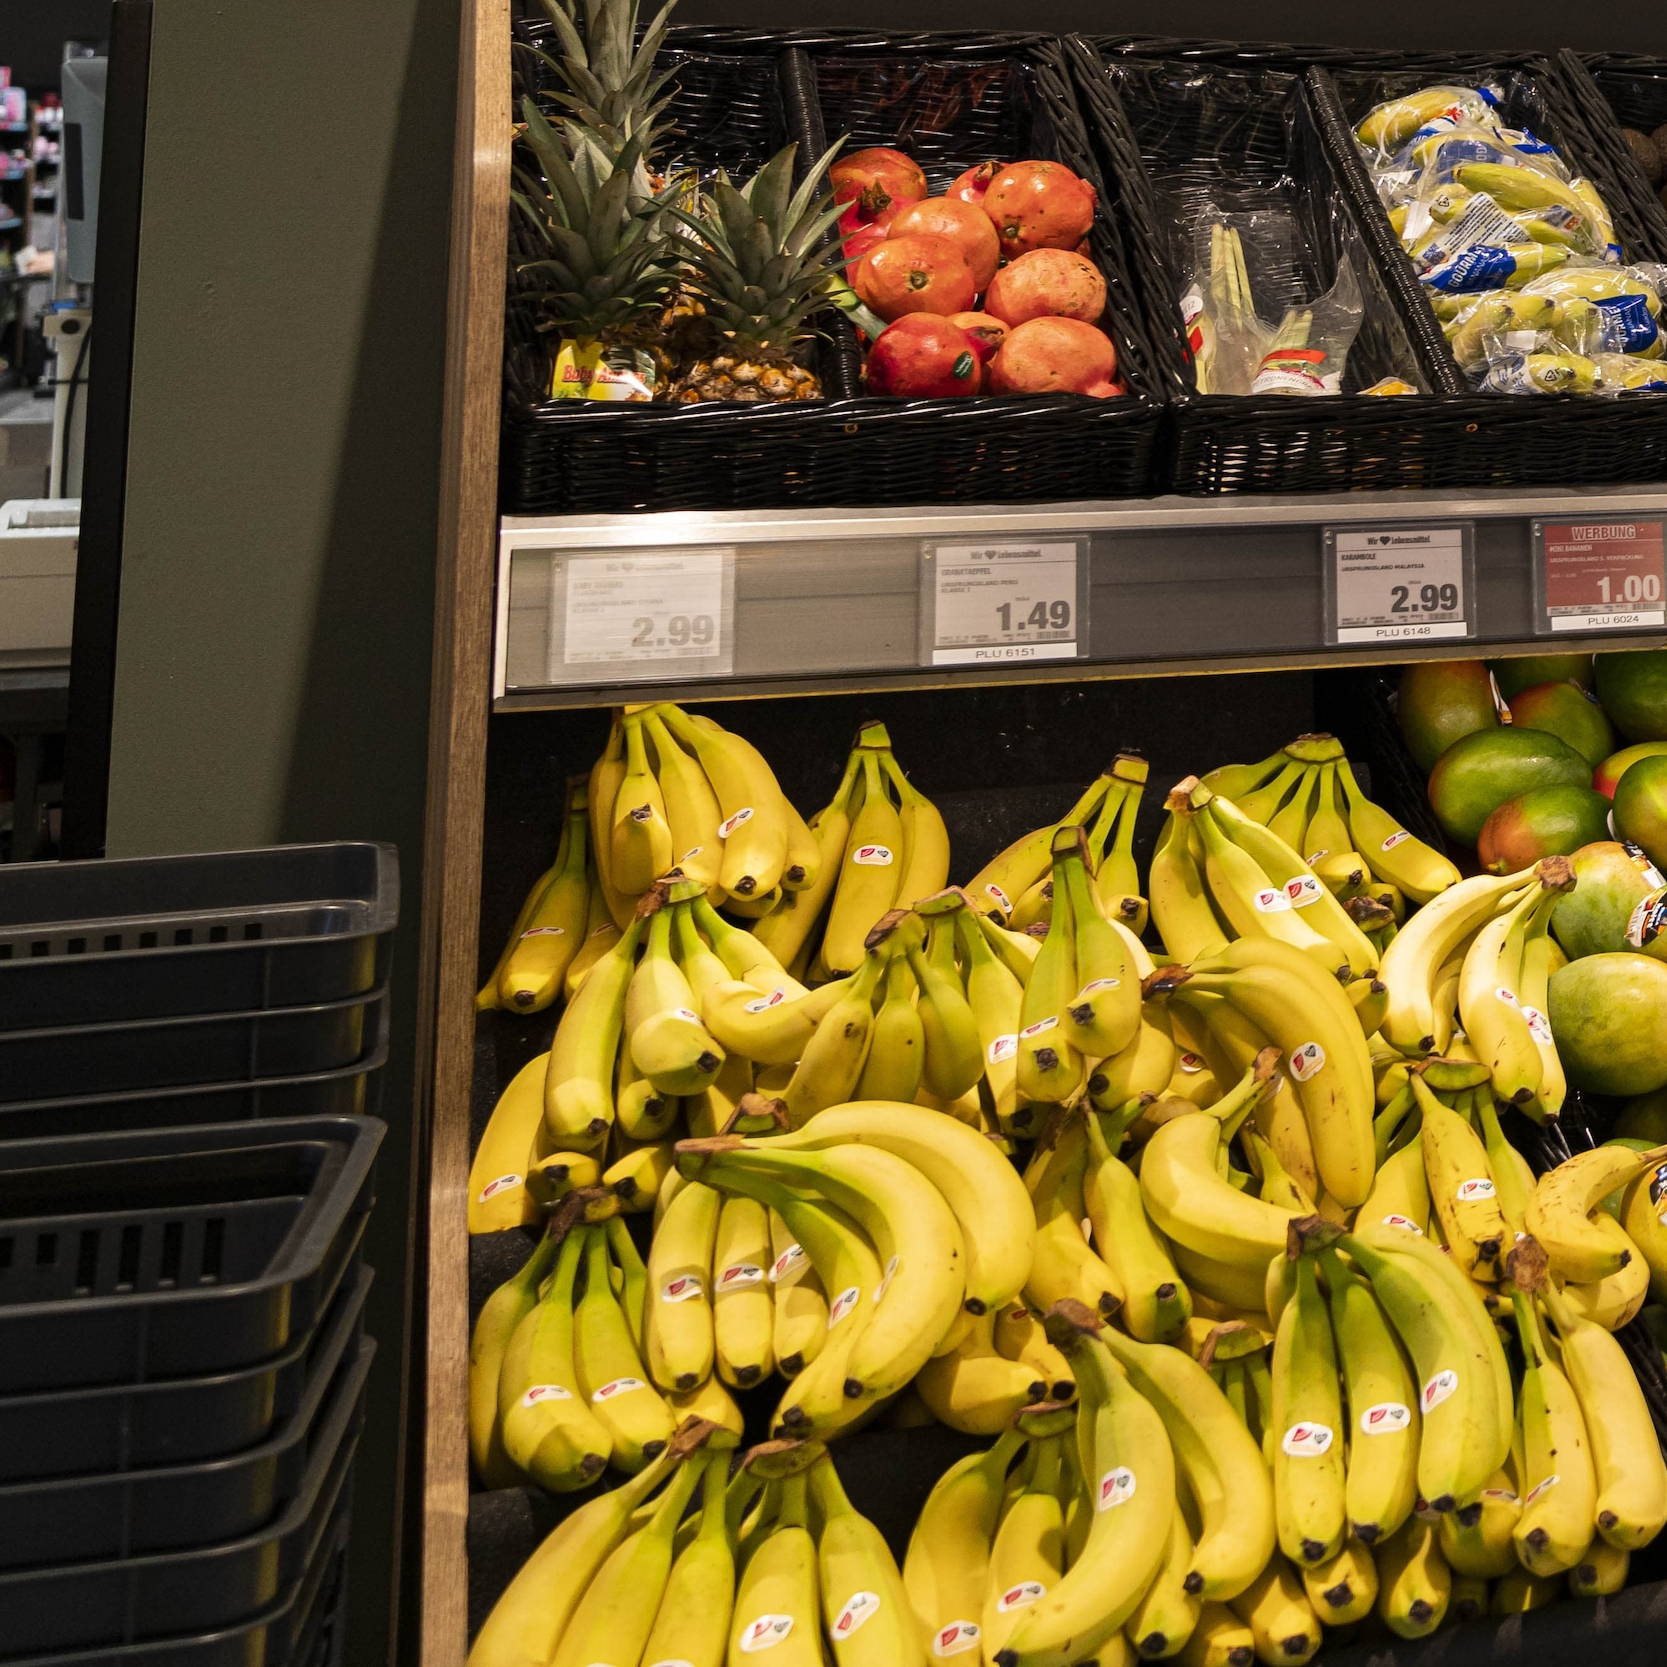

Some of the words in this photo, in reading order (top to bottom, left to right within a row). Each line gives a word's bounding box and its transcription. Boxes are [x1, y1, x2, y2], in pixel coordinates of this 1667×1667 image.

[1572, 525, 1636, 540] WERBUNG
[1391, 583, 1458, 613] 2.99
[1597, 574, 1661, 603] 1.00
[996, 600, 1070, 631] 1.49
[1588, 617, 1610, 625] PLU
[1613, 615, 1639, 624] 6024
[631, 615, 714, 648] 2.99
[1376, 629, 1400, 637] PLU
[1403, 627, 1431, 635] 6148
[975, 650, 1002, 659] PLU
[1005, 648, 1035, 658] 6151
